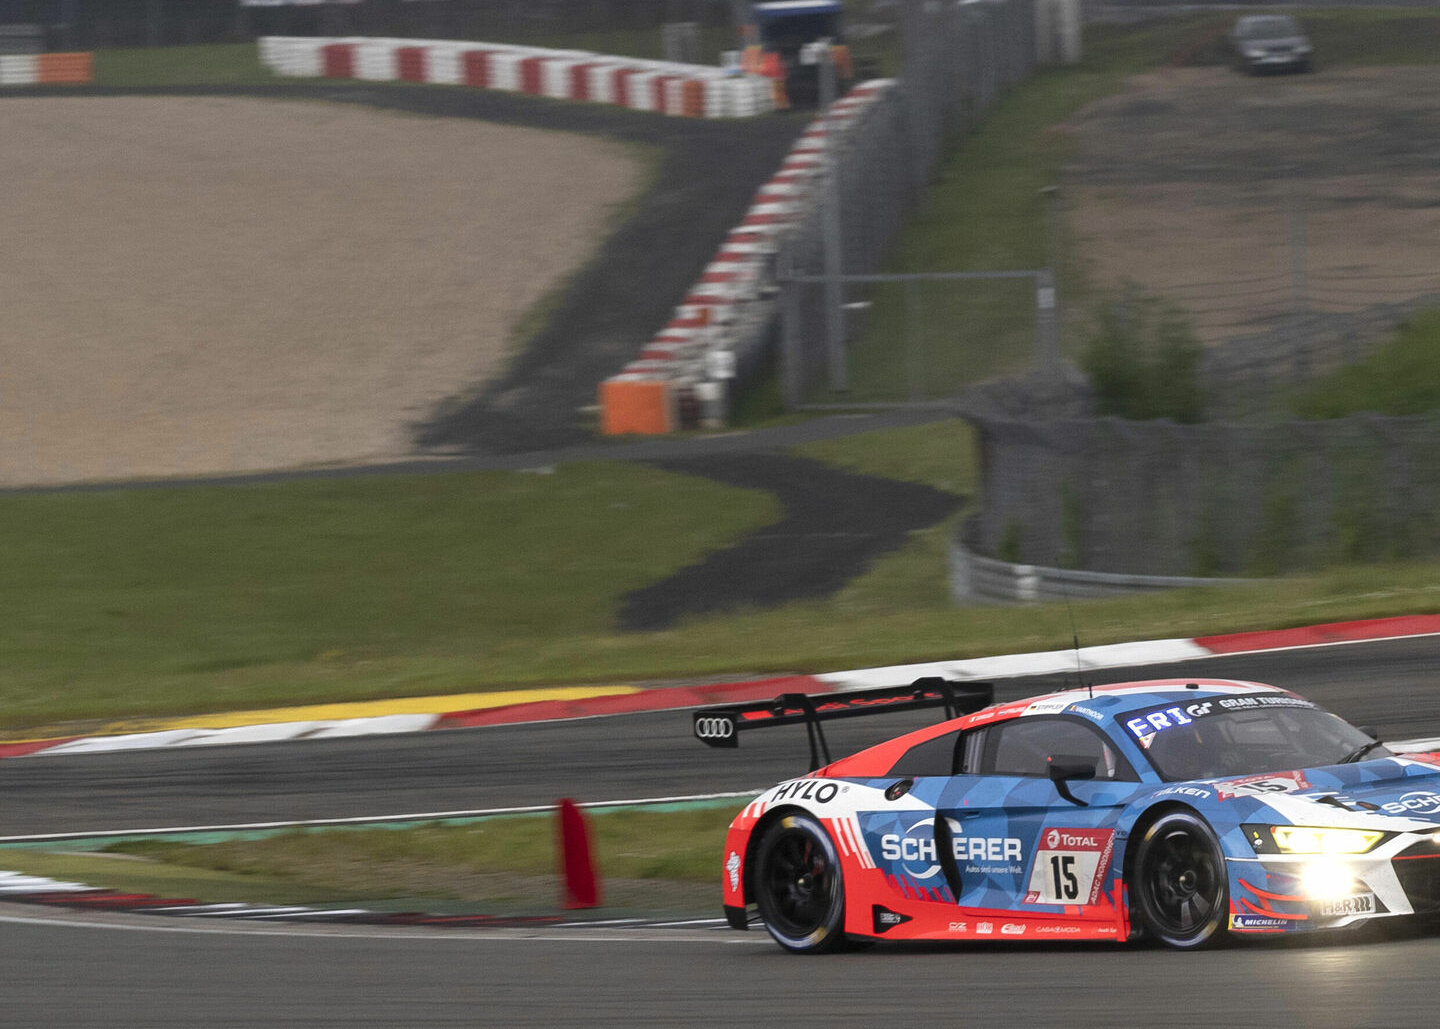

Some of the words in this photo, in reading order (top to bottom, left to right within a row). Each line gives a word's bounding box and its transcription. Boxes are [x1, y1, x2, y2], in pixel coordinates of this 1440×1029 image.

[1219, 697, 1259, 708] GRAN
[770, 780, 840, 804] HYLO
[1236, 781, 1289, 793] 15
[880, 833, 1023, 861] SCHERER
[1061, 834, 1099, 847] TOTAL
[1050, 855, 1079, 900] 15
[1091, 879, 1101, 906] ADAC
[1244, 918, 1288, 926] MICHELIN
